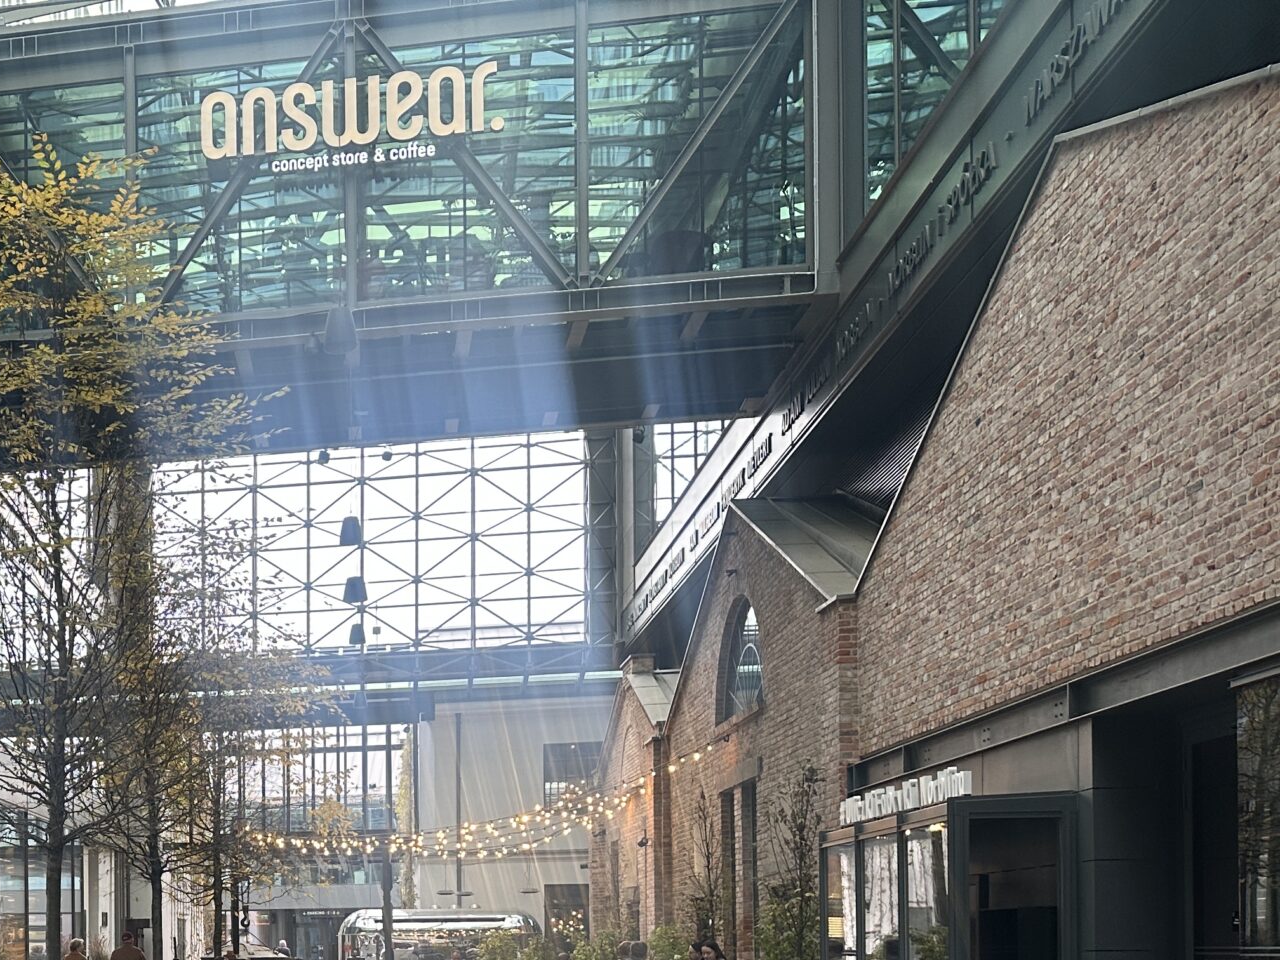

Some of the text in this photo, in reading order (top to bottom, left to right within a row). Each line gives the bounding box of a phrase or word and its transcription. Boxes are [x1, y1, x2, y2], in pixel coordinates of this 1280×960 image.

[200, 61, 505, 160] answear.
[272, 142, 436, 173] concept store & coffee
[782, 392, 805, 436] ADAM
[888, 215, 936, 299] NORBLIN
[946, 141, 997, 225] SPÓŁKA
